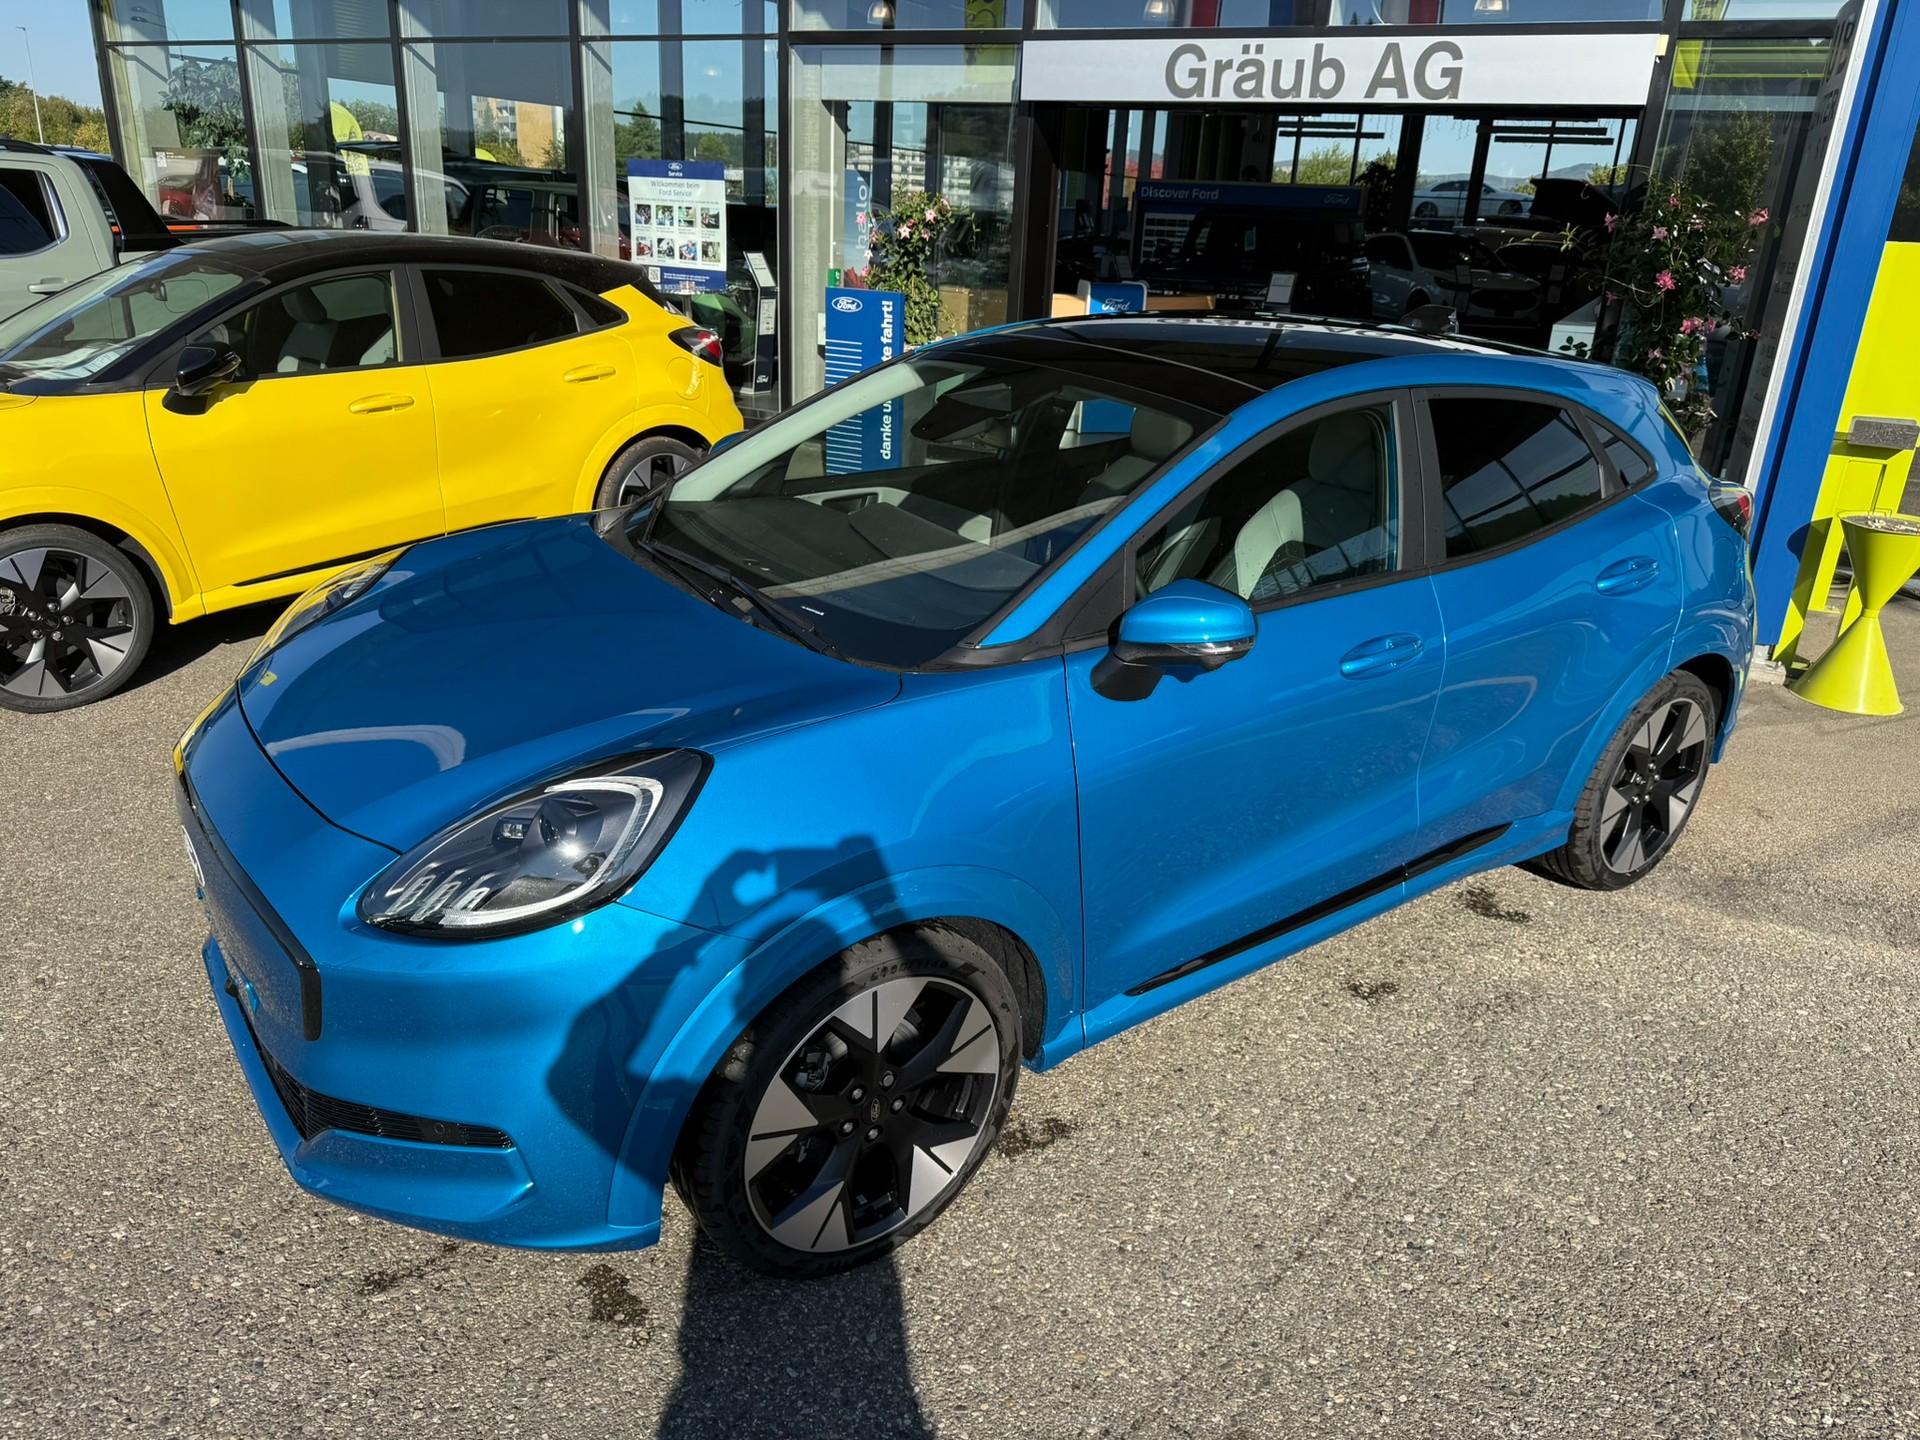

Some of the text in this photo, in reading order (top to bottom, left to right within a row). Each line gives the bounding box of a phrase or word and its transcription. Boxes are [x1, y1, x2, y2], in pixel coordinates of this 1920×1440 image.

[1165, 40, 1464, 100] Gräub AG
[1141, 186, 1219, 200] Discover Ford
[1324, 193, 1350, 204] Ford
[1101, 298, 1130, 311] Ford
[881, 301, 893, 344] fahrt!
[881, 347, 893, 363] te
[880, 415, 892, 460] danke
